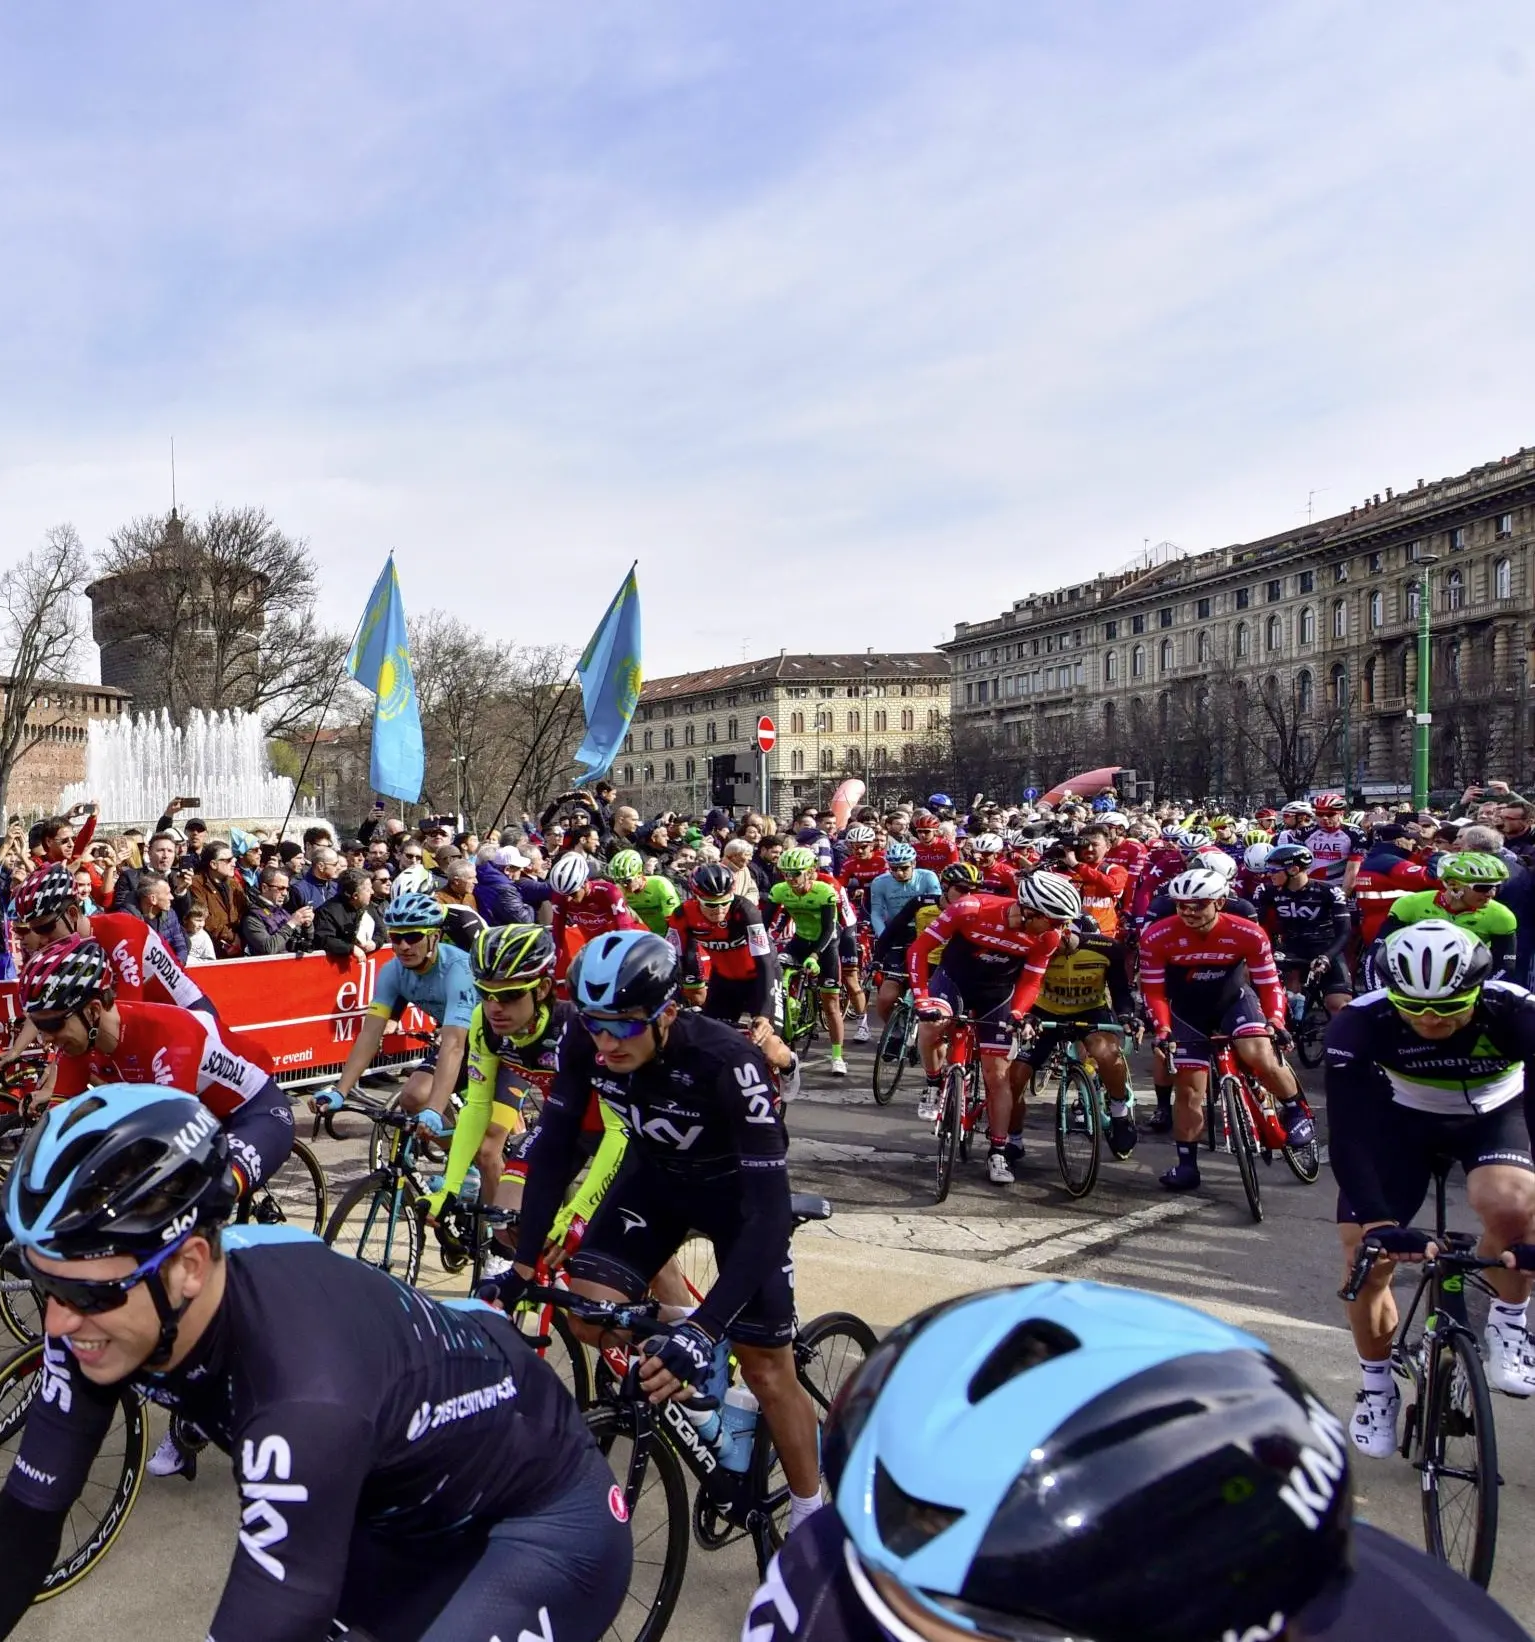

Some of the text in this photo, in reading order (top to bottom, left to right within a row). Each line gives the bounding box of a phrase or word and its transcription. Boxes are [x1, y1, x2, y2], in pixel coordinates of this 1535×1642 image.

[1313, 843, 1341, 851] UAE
[1277, 902, 1320, 920] sky
[970, 931, 1030, 952] TREK
[1171, 953, 1235, 961] TREK
[145, 946, 181, 990] SOUDAL
[1390, 958, 1406, 989] MET
[1451, 961, 1468, 989] MET
[202, 1051, 246, 1087] SOUDAL
[282, 1049, 313, 1066] eventi
[733, 1062, 775, 1125] sky
[602, 1097, 704, 1150] sky
[517, 1126, 544, 1159] URSUS
[161, 1206, 199, 1242] sky
[664, 1402, 717, 1474] OGMA
[15, 1455, 57, 1486] DANNY
[238, 1434, 309, 1582] sky
